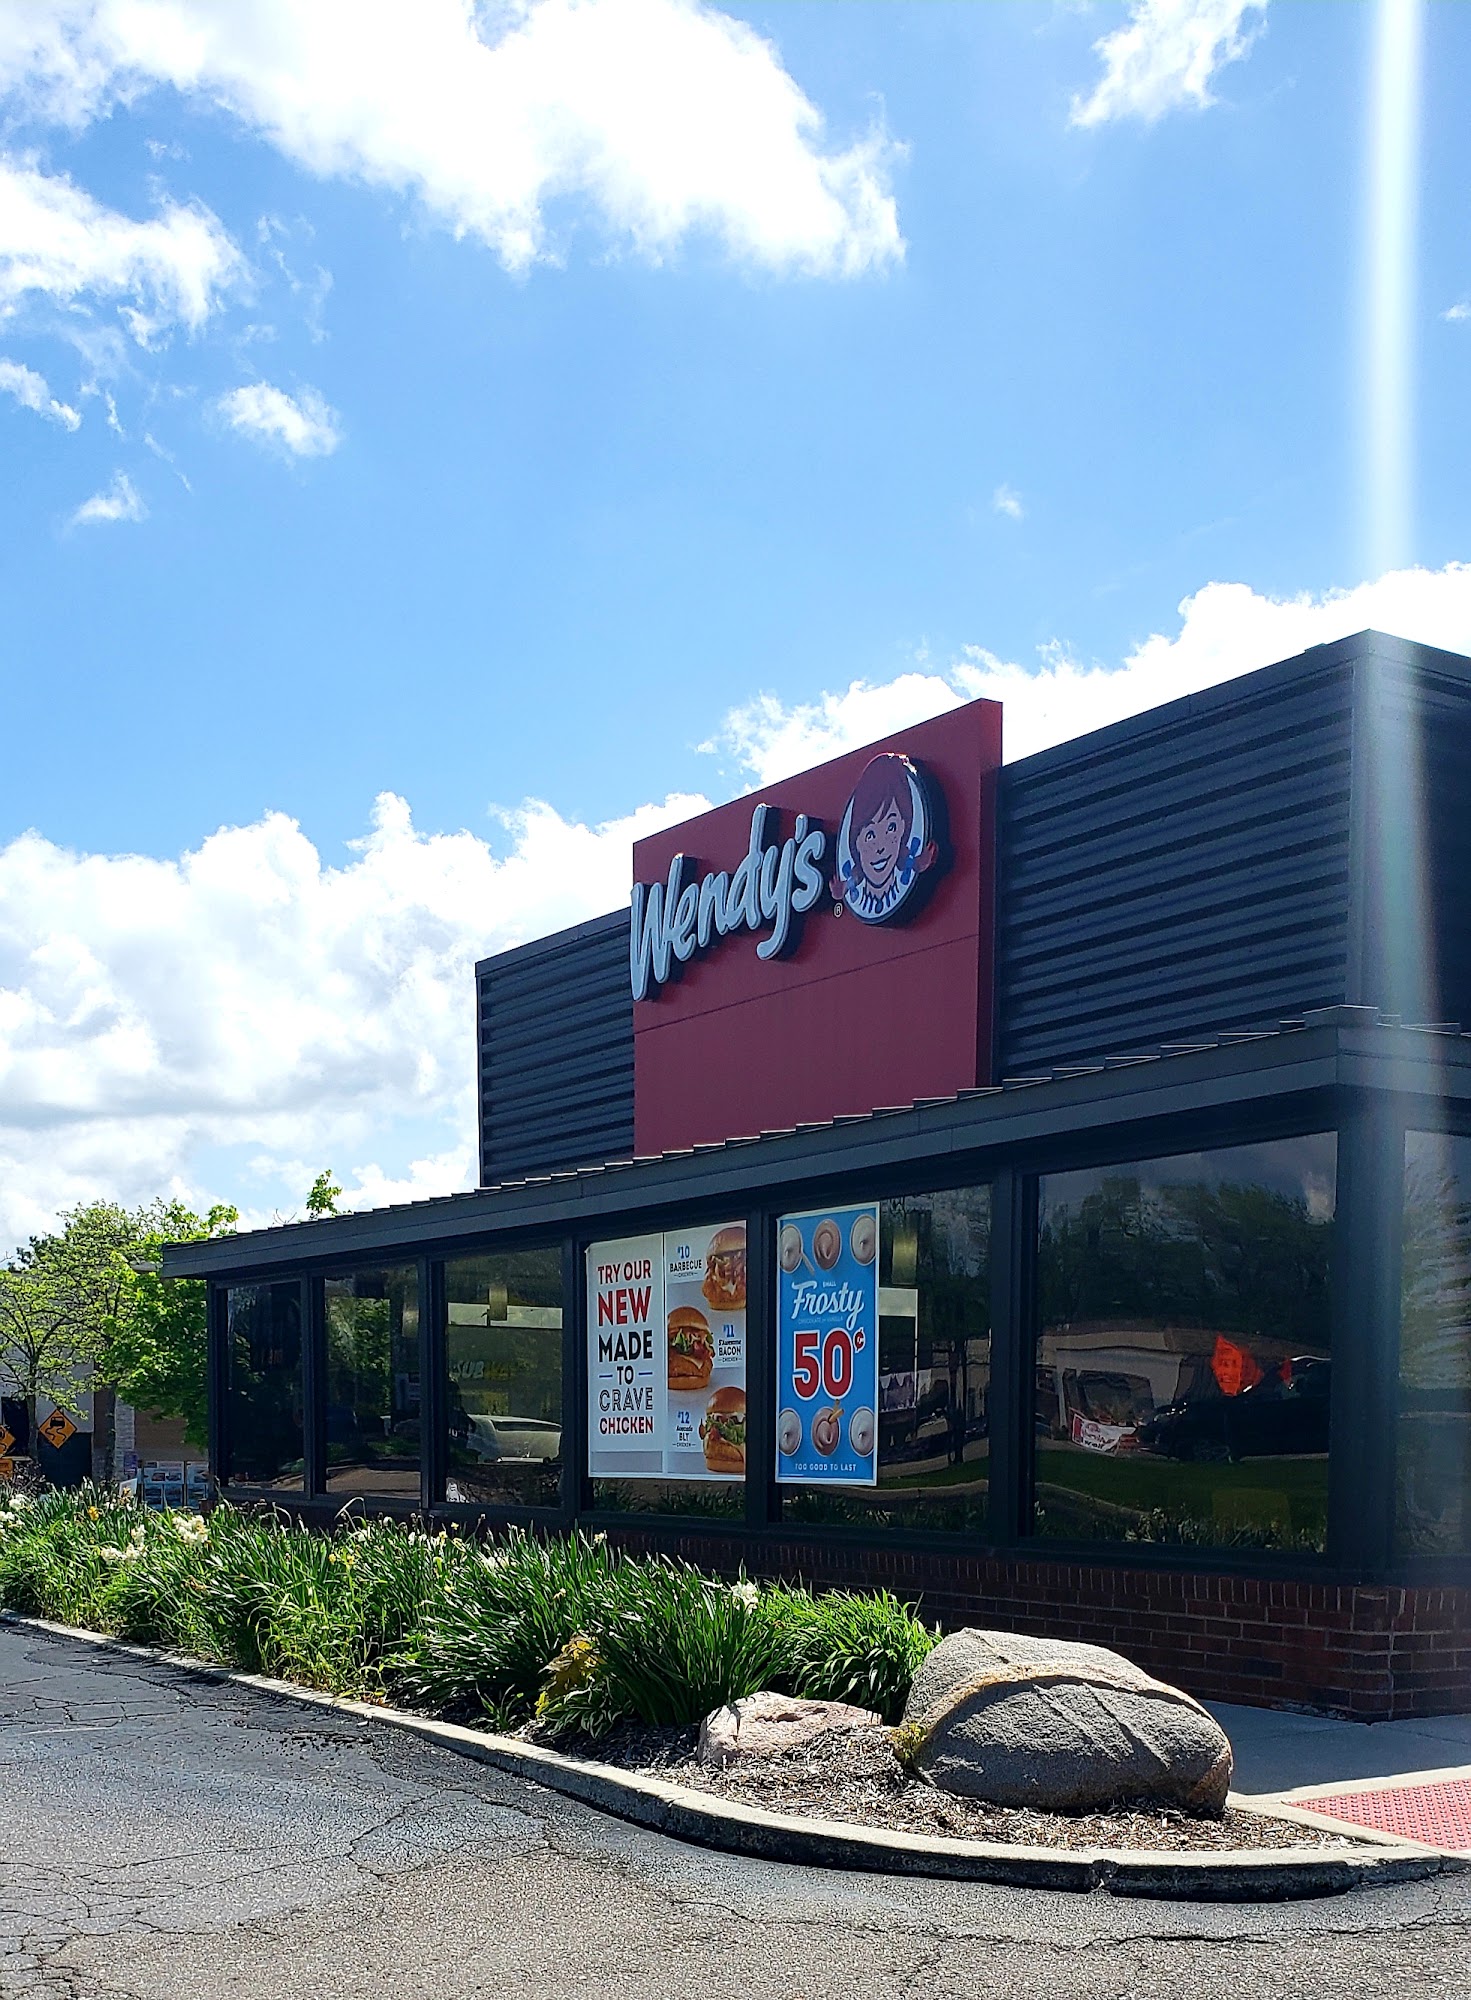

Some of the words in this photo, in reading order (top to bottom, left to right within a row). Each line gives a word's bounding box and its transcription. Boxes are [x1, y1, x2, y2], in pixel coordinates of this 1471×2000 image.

[630, 803, 826, 1001] Wendy's
[598, 1263, 621, 1285] TRY
[624, 1260, 651, 1281] OUR
[670, 1260, 702, 1272] BARBECUE
[598, 1286, 652, 1327] NEW
[791, 1281, 864, 1331] Frosty
[598, 1330, 653, 1362] MADE
[719, 1346, 742, 1356] BACON
[617, 1366, 634, 1385] TO
[600, 1387, 653, 1411] CRAVE
[600, 1416, 653, 1434] CHICKEN
[679, 1432, 689, 1441] BLT
[795, 1463, 807, 1471] TOO
[809, 1463, 828, 1471] GOOD
[840, 1464, 856, 1472] LAST
